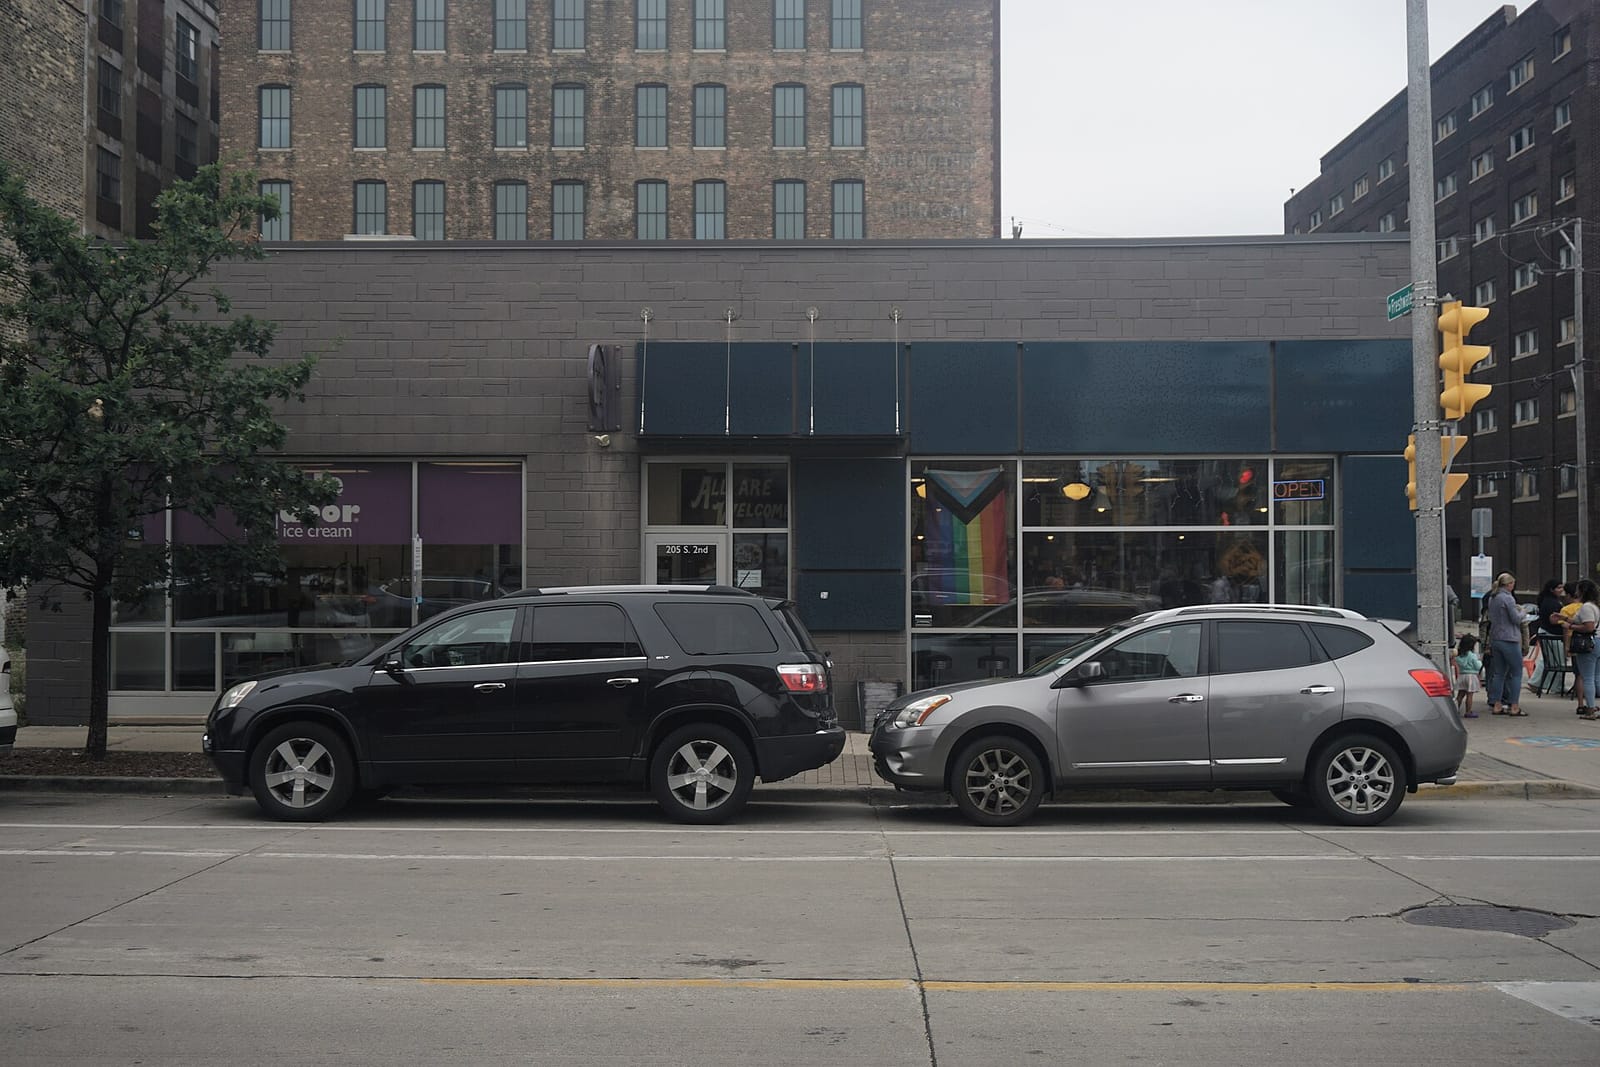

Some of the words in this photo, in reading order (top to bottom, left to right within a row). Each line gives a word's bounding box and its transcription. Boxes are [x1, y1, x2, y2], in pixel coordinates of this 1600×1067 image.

[691, 475, 726, 509] ALL
[738, 479, 772, 496] ARE
[1274, 482, 1321, 497] OPEN
[283, 524, 303, 537] ice
[307, 527, 352, 537] cream
[665, 545, 681, 554] 205
[683, 545, 691, 554] S.
[692, 545, 709, 554] 2nd
